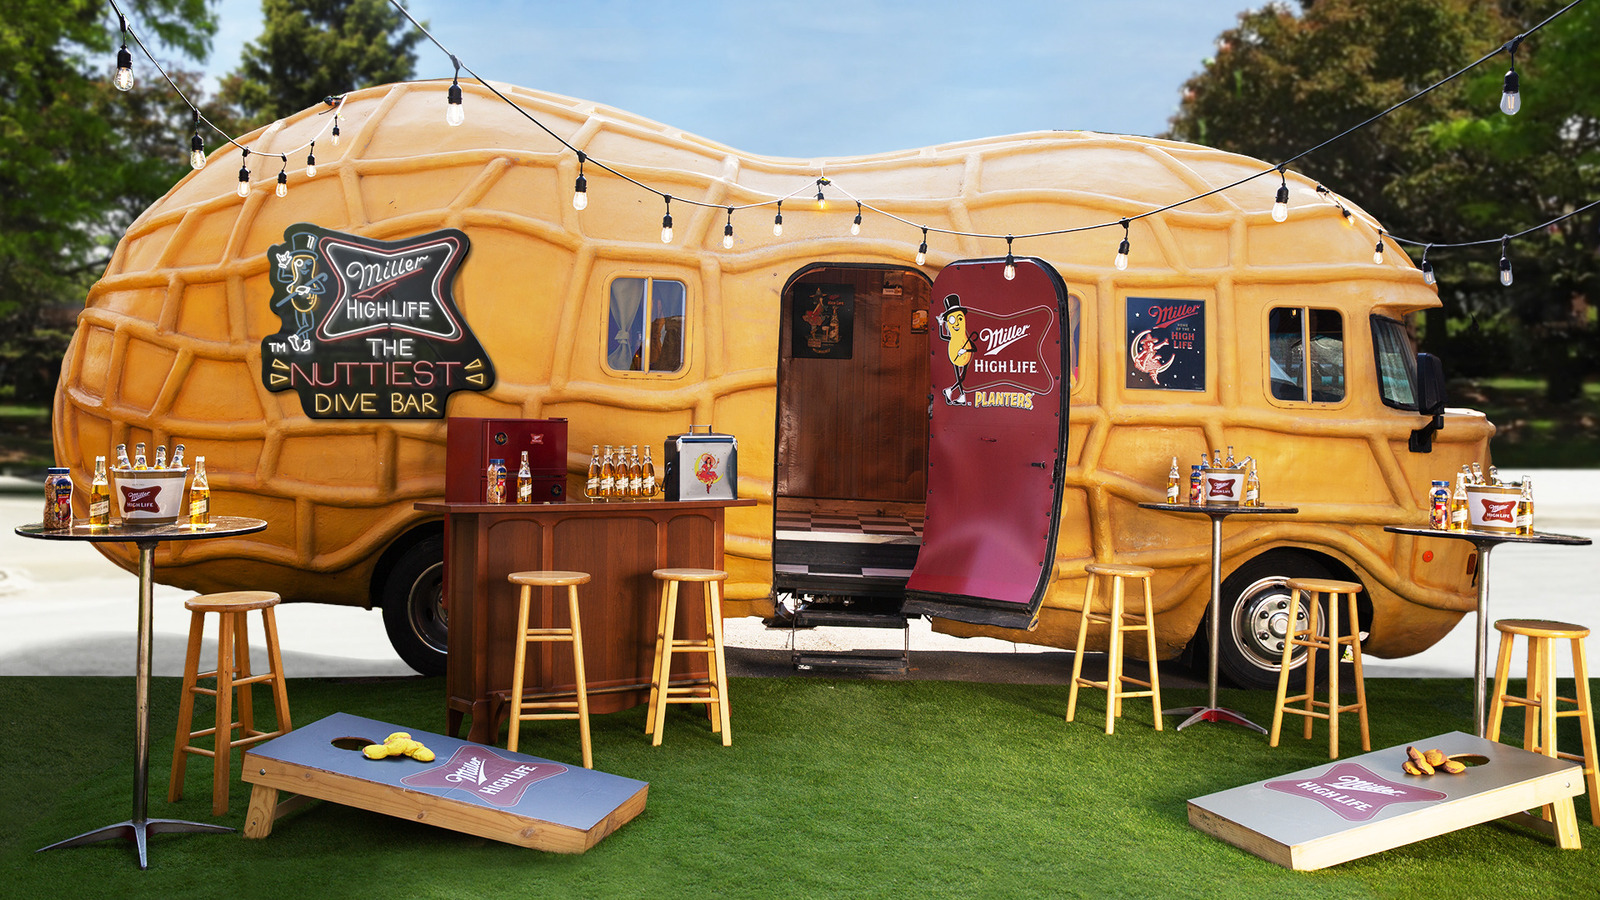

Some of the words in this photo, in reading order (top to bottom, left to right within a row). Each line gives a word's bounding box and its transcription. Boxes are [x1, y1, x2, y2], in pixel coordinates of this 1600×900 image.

[346, 255, 429, 290] Miller
[347, 299, 388, 319] HIGH
[391, 301, 430, 318] LIFE
[1148, 304, 1200, 325] Miller
[979, 324, 1031, 352] Miller
[1172, 332, 1194, 340] HIGH
[1174, 340, 1192, 350] LIFE
[268, 342, 287, 353] TM
[366, 338, 414, 356] THE
[290, 361, 461, 386] NUTTIEST
[974, 359, 1007, 373] HIGH
[1009, 360, 1037, 374] LIFE
[315, 393, 377, 412] DIVE
[390, 392, 438, 413] BAR
[974, 391, 1035, 410] PLANTERS
[444, 756, 482, 784] Miller
[479, 776, 515, 796] HIGH
[508, 764, 536, 780] LIFE
[1333, 775, 1407, 796] Miller
[1296, 782, 1338, 800] HIGH
[1335, 794, 1373, 812] LIFE
